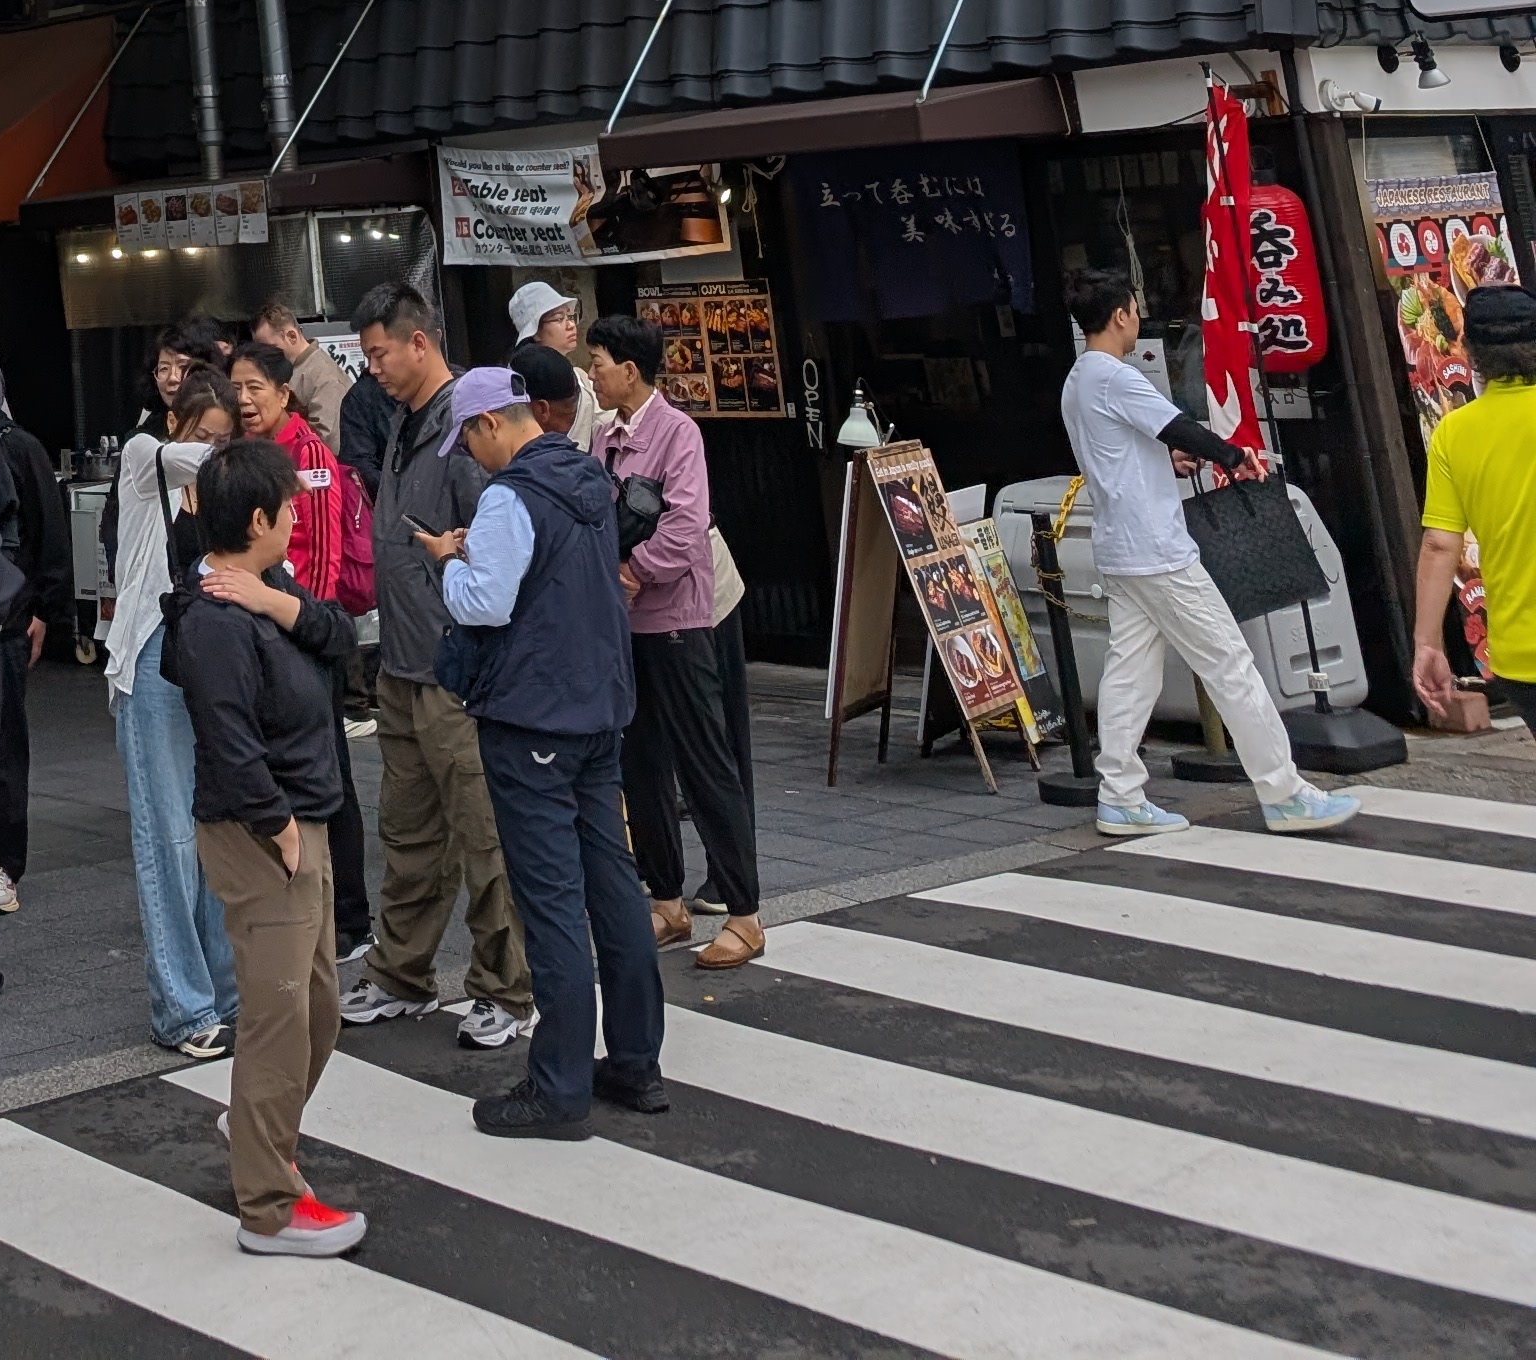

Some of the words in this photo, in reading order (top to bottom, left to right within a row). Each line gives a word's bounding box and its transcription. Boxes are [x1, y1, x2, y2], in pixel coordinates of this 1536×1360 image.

[468, 162, 481, 171] you
[462, 178, 509, 201] Table
[512, 184, 548, 203] seat
[819, 173, 985, 208] 立って呑むには
[1375, 186, 1427, 208] JAPANESE
[1426, 182, 1490, 203] RESTAURANT
[473, 218, 527, 242] Counter
[530, 222, 566, 242] seat
[900, 208, 1017, 243] 美味すぎる
[637, 286, 663, 298] BOWL
[1249, 208, 1313, 355] 呑み処
[802, 358, 824, 450] OPEN
